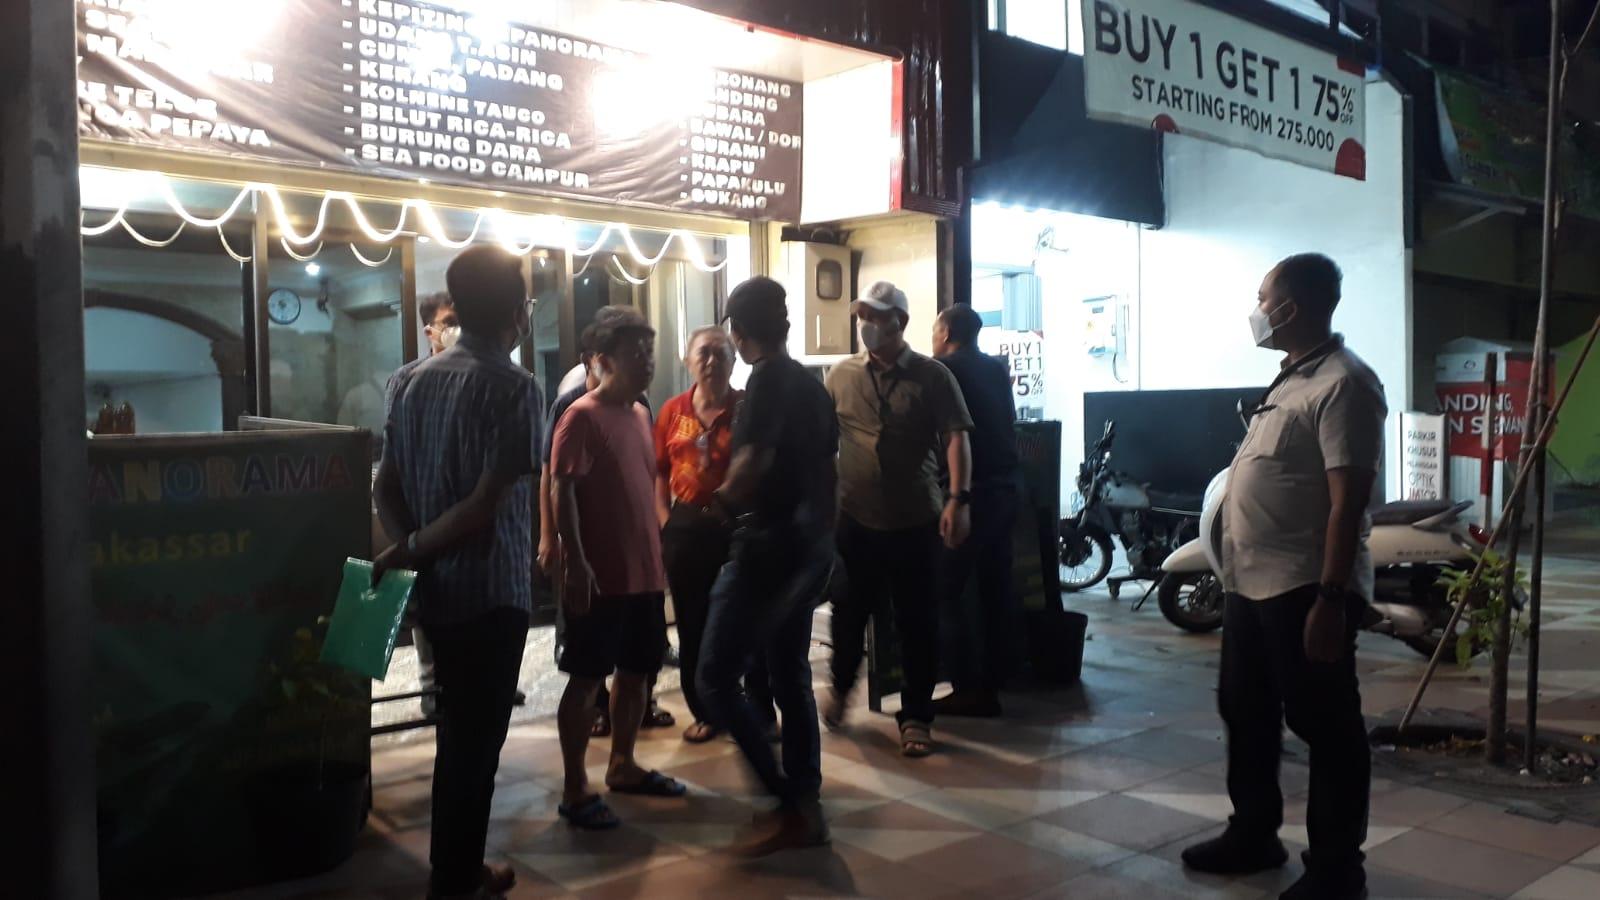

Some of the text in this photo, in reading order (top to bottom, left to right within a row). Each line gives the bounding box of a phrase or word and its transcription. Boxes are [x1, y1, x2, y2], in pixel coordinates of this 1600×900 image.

[1094, 1, 1176, 70] BUY
[1190, 32, 1203, 79] 1
[1216, 41, 1280, 102] GET
[1290, 67, 1300, 110] 1
[150, 113, 272, 148] PEPAYA
[360, 102, 572, 150] BELUT RICA-RICA
[473, 100, 546, 126] TAUCO
[1132, 74, 1334, 152] STARTING FROM 275.000
[1340, 113, 1355, 125] OFF
[360, 123, 542, 164] BURUNG DARA
[361, 143, 590, 189] SEA FOOD CAMPUR
[691, 153, 755, 174] KRAPU
[691, 171, 786, 195] PAPAKULU
[1408, 431, 1436, 441] PARKIR
[88, 453, 352, 503] ANORAMA
[85, 528, 255, 567] akassar
